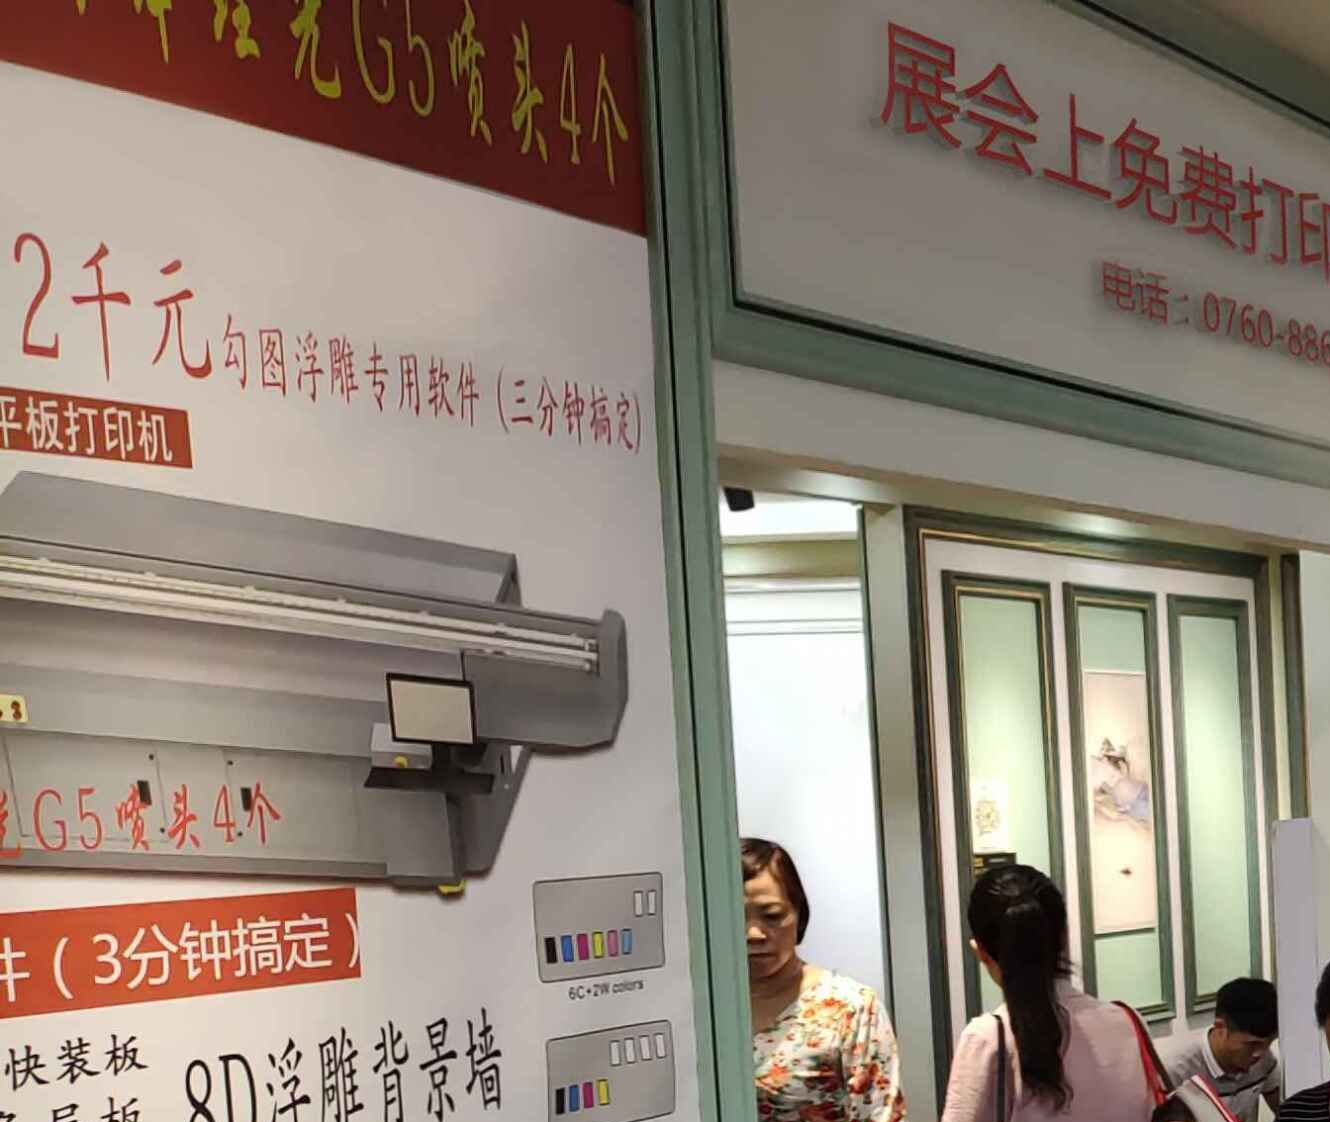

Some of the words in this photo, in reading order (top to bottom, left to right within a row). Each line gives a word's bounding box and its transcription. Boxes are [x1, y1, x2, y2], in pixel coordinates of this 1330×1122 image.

[0, 395, 174, 462] 平板打印机
[568, 982, 610, 1001] 6C+2W
[612, 979, 645, 994] colors
[4, 1033, 149, 1092] 快装板
